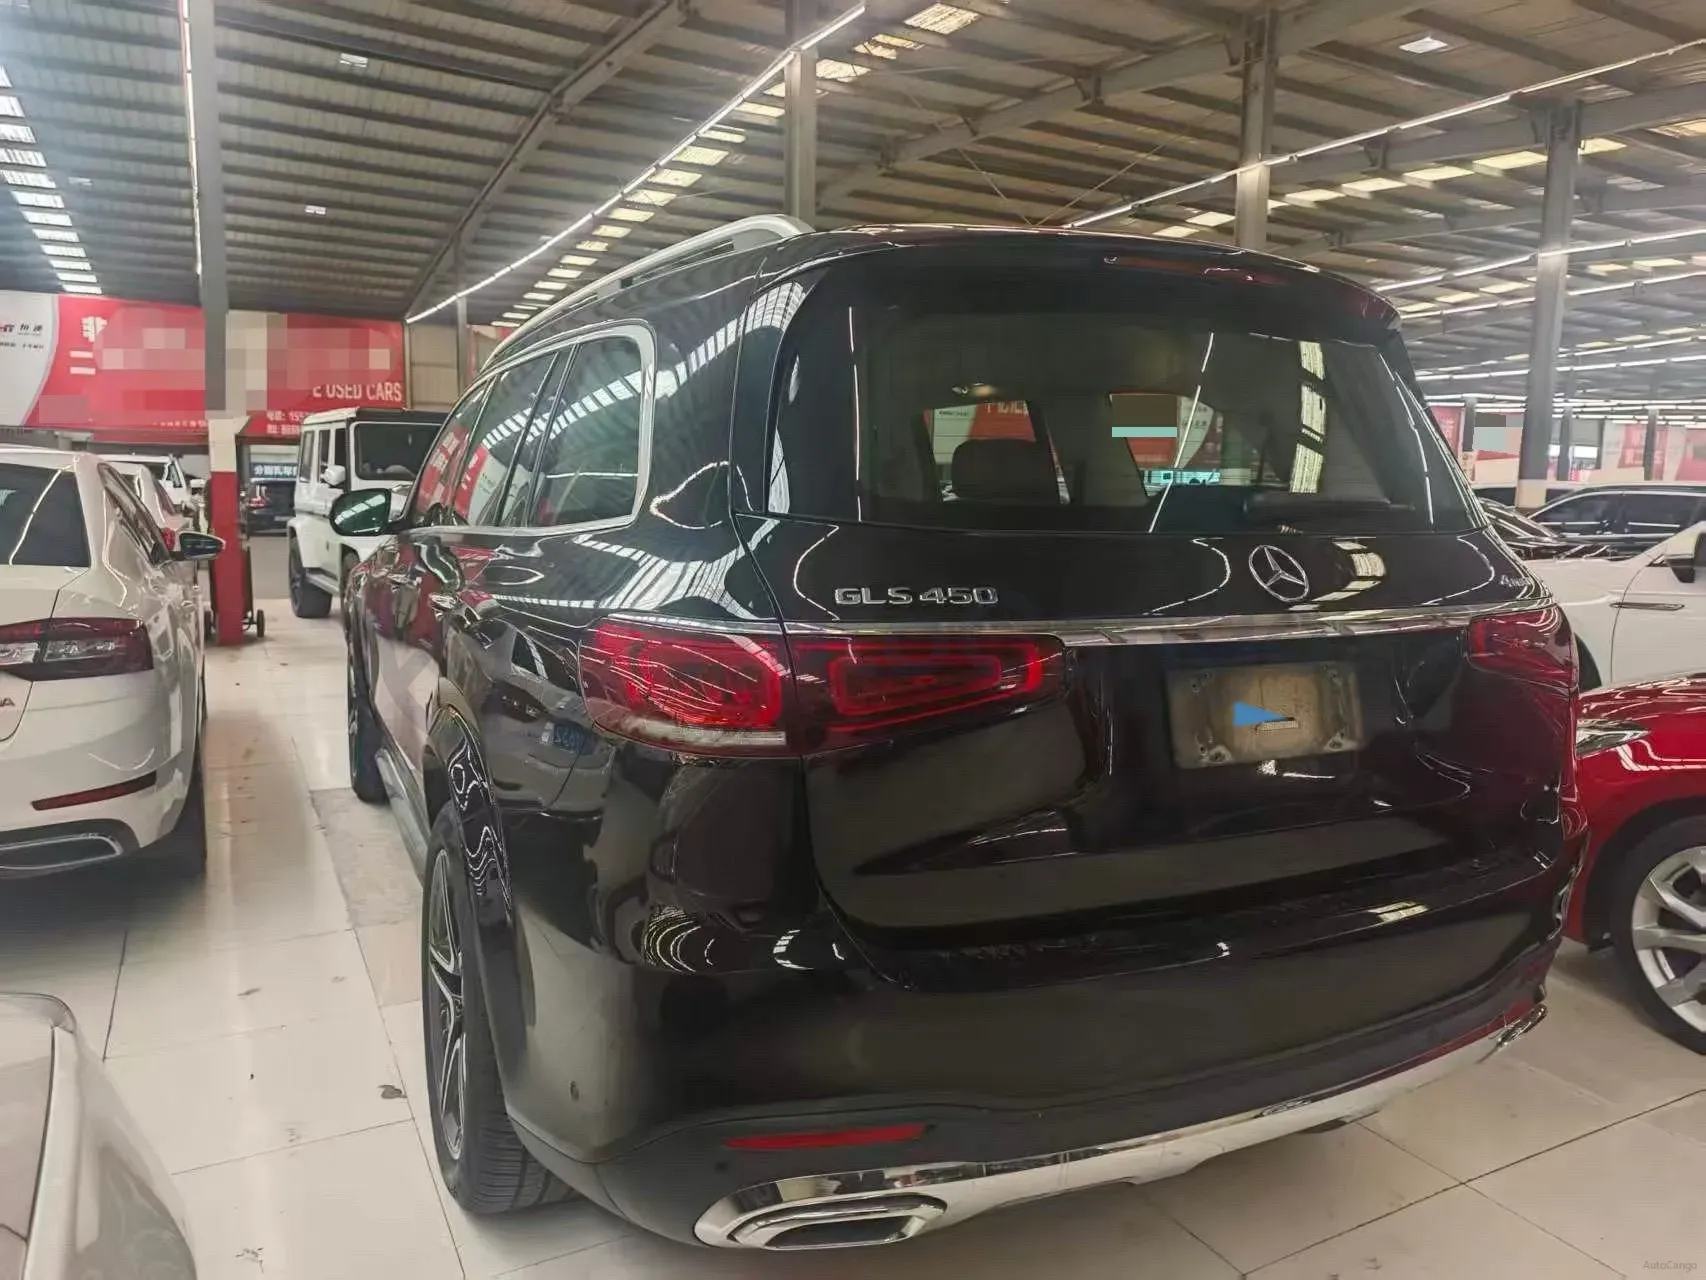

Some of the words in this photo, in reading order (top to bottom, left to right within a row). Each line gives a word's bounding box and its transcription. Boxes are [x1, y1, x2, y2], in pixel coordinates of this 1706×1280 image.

[326, 384, 362, 399] USED
[366, 382, 402, 401] CARS
[834, 587, 913, 605] GLS
[919, 587, 999, 605] 450
